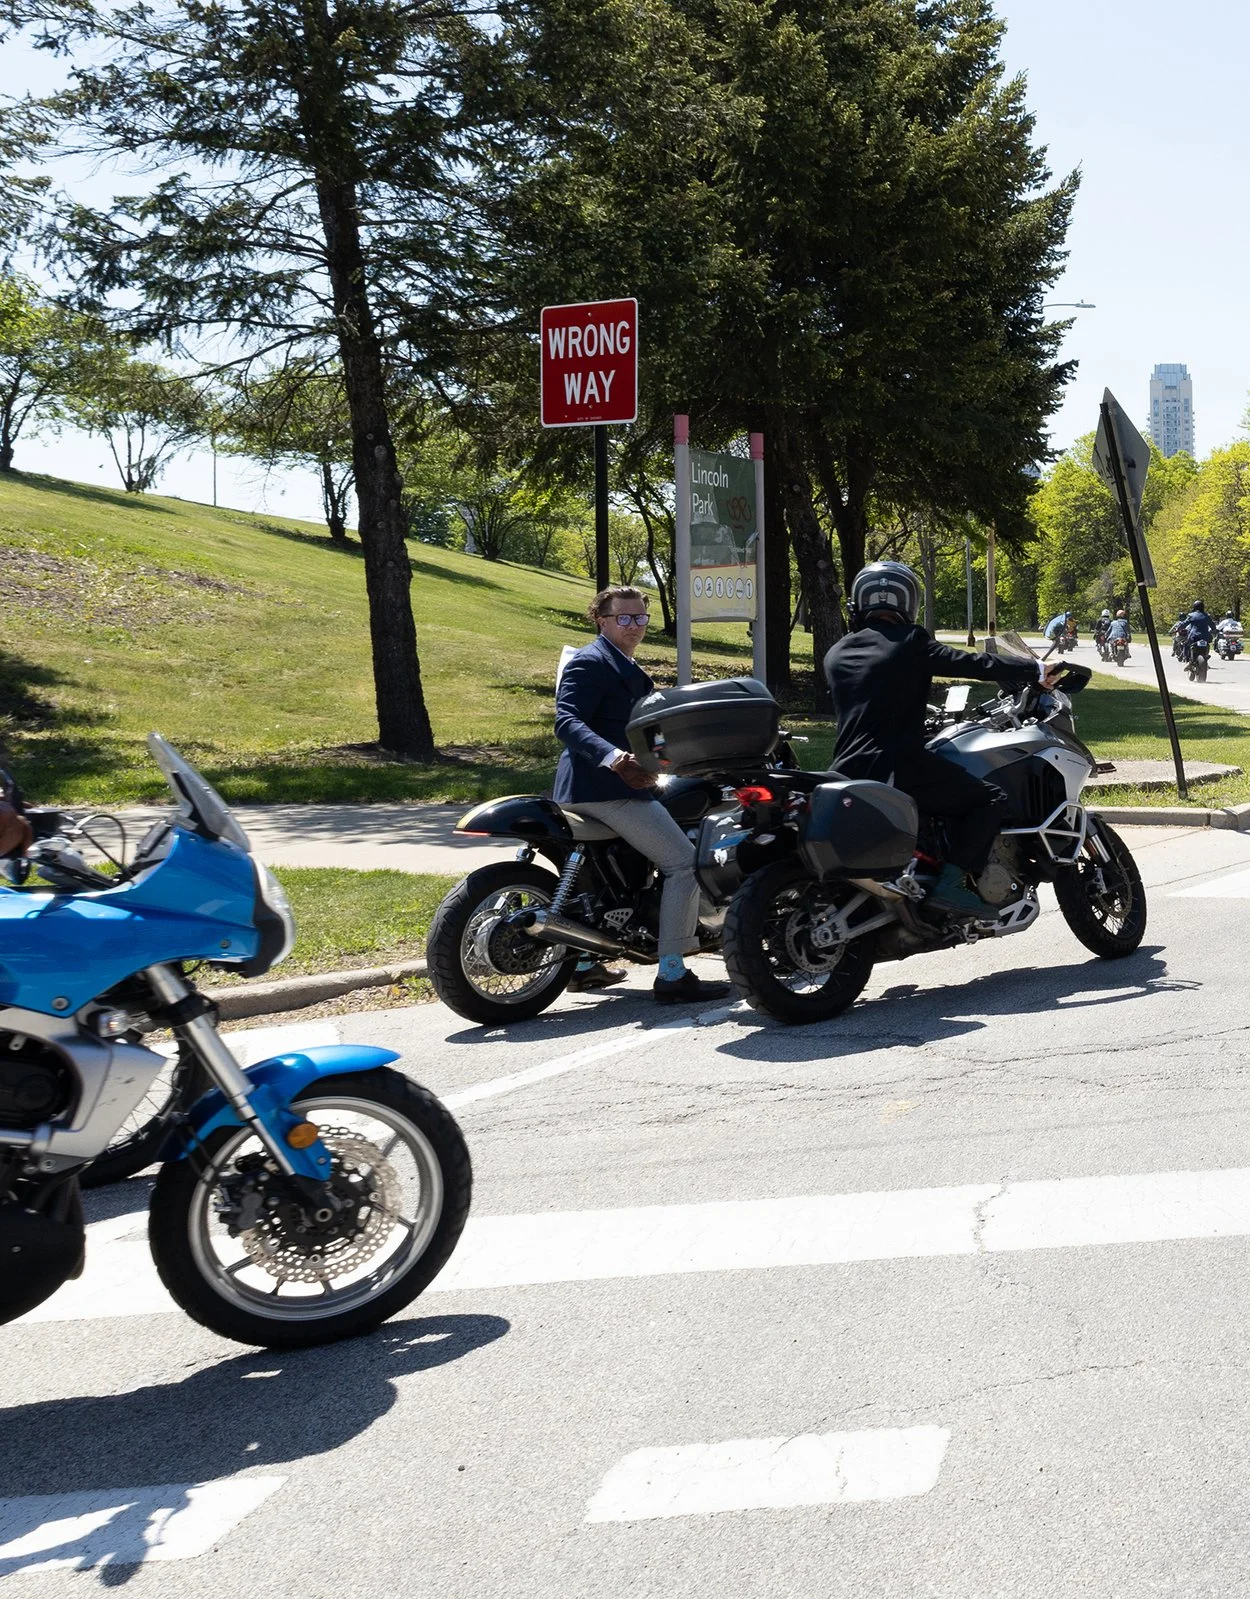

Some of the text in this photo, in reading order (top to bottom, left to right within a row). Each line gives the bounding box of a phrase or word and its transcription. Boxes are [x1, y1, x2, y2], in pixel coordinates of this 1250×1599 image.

[548, 321, 631, 360] WRONG
[563, 370, 616, 405] WAY
[691, 462, 729, 489] Lincoln
[692, 493, 714, 515] Park
